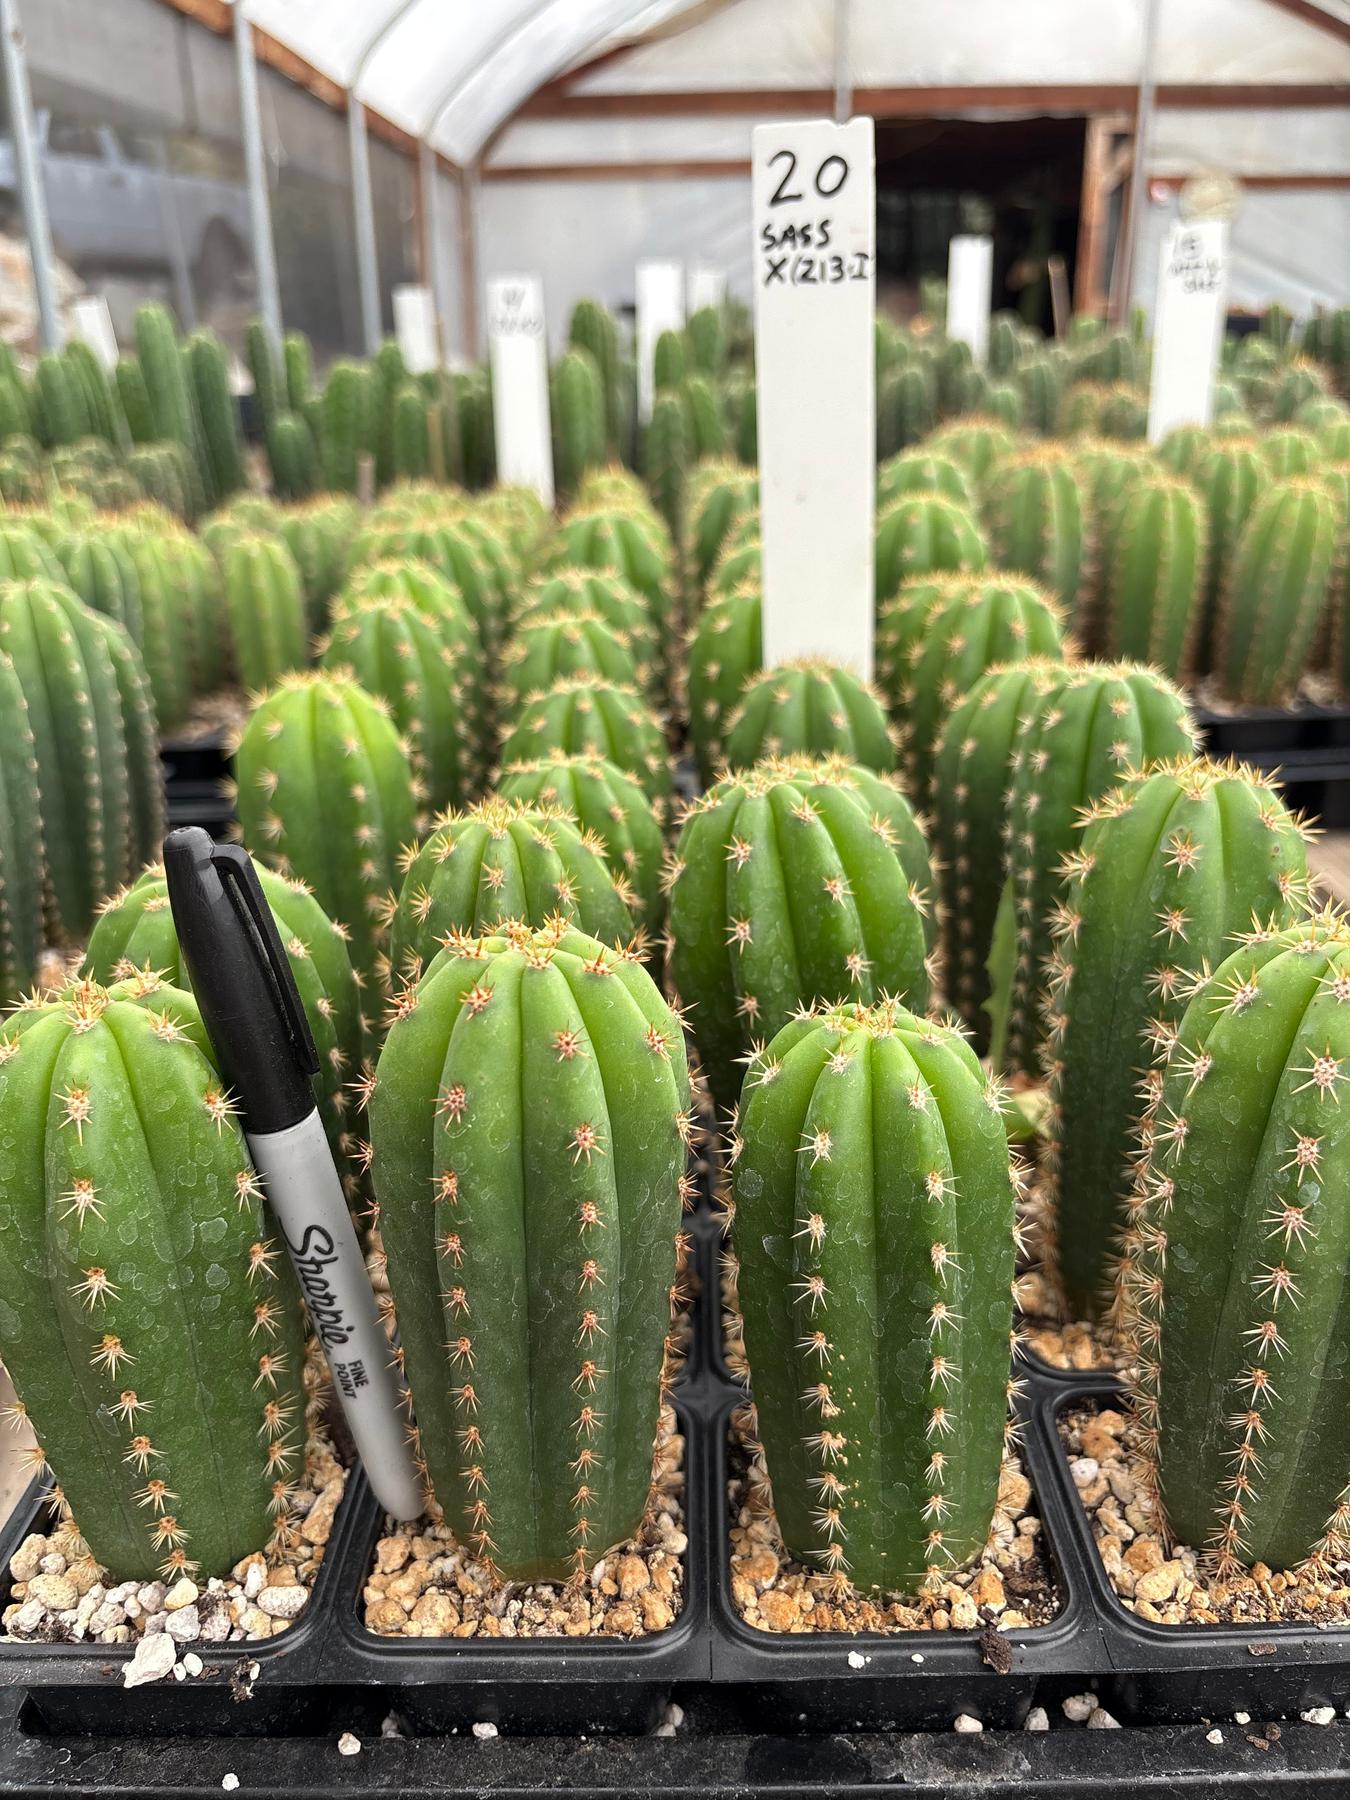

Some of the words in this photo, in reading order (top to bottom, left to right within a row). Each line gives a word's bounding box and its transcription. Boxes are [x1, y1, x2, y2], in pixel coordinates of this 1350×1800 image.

[768, 150, 848, 208] 20
[763, 219, 831, 251] SASS
[278, 1216, 355, 1350] Sharpie
[334, 1362, 357, 1399] POINT
[348, 1359, 369, 1388] FINE
